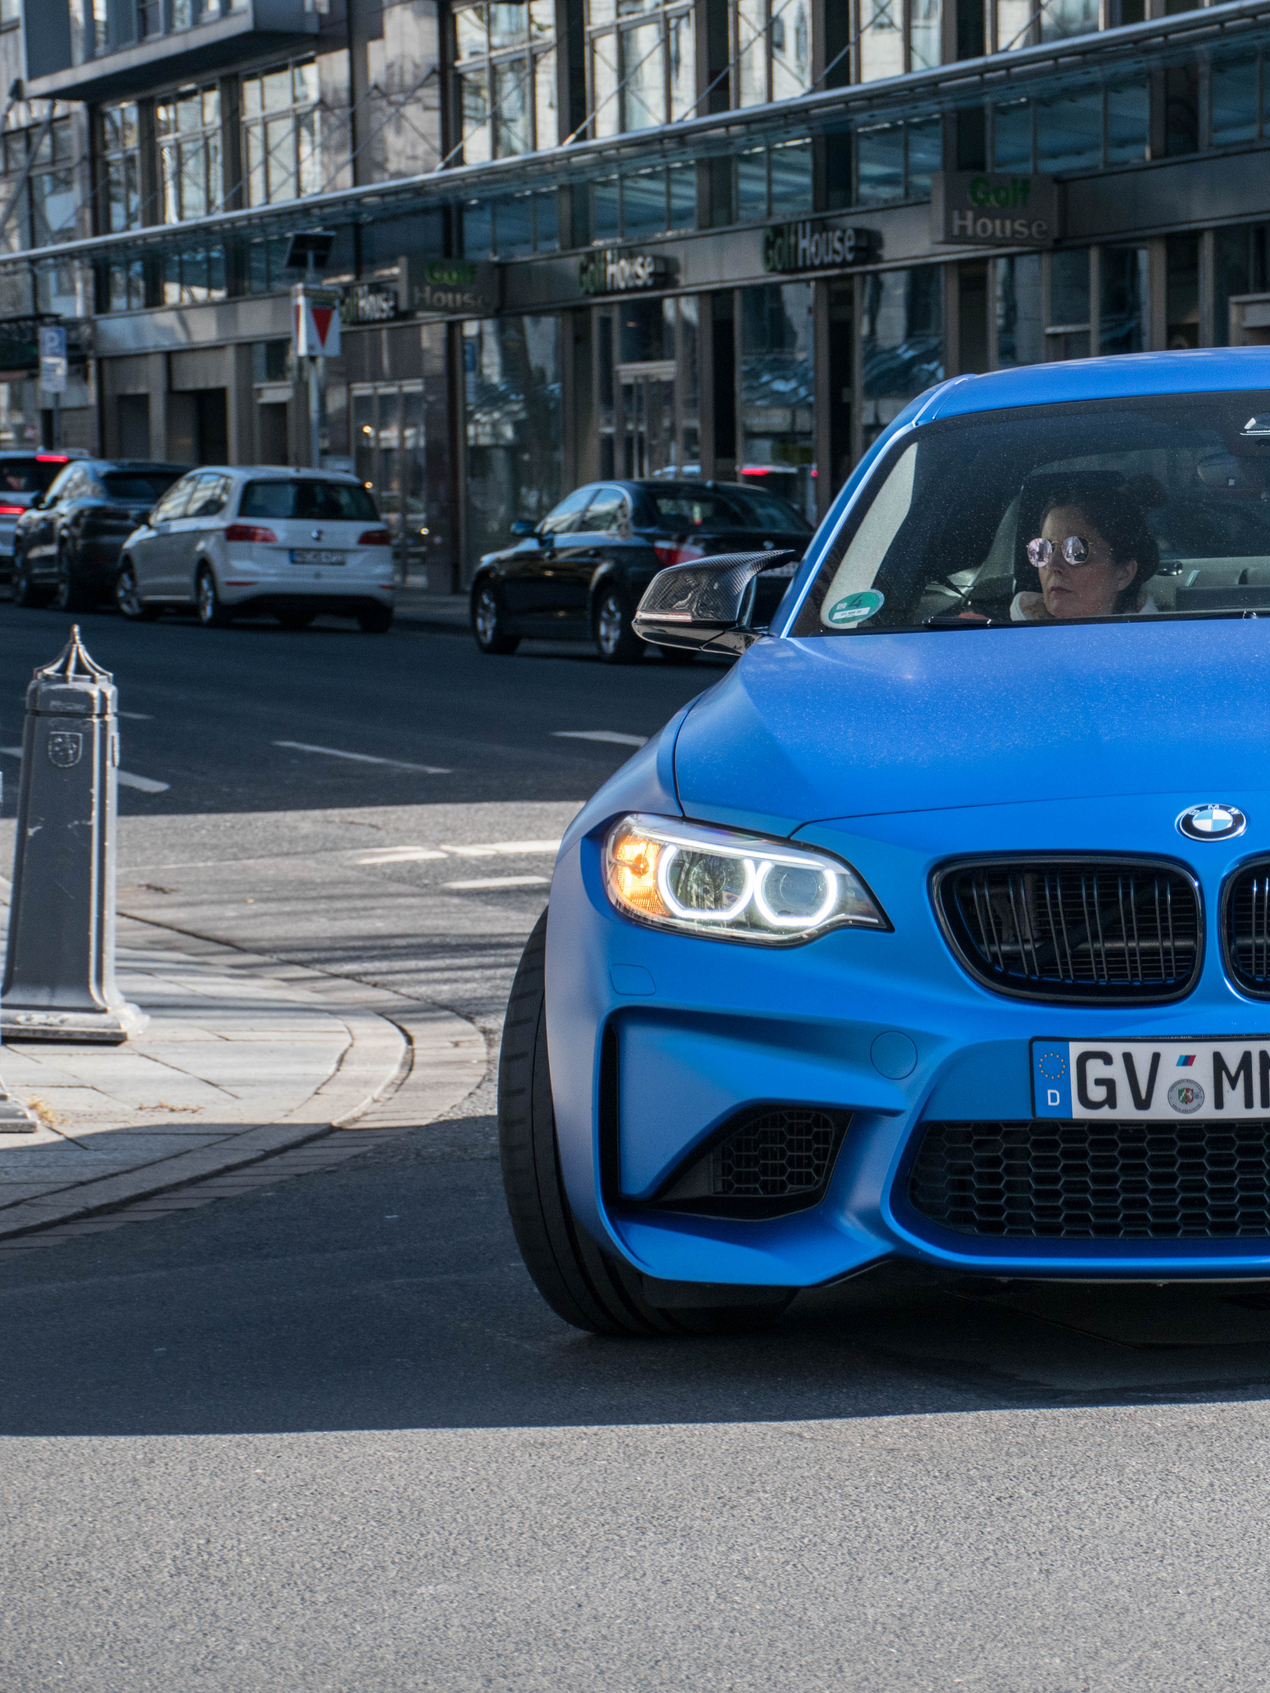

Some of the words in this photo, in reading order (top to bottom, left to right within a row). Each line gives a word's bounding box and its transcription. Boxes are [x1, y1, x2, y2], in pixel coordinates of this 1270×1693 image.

[969, 178, 1031, 208] Golf
[951, 209, 1048, 239] House
[426, 260, 478, 285] Golf
[413, 285, 491, 312] House
[1076, 1050, 1161, 1110] GV
[1047, 1089, 1061, 1106] D
